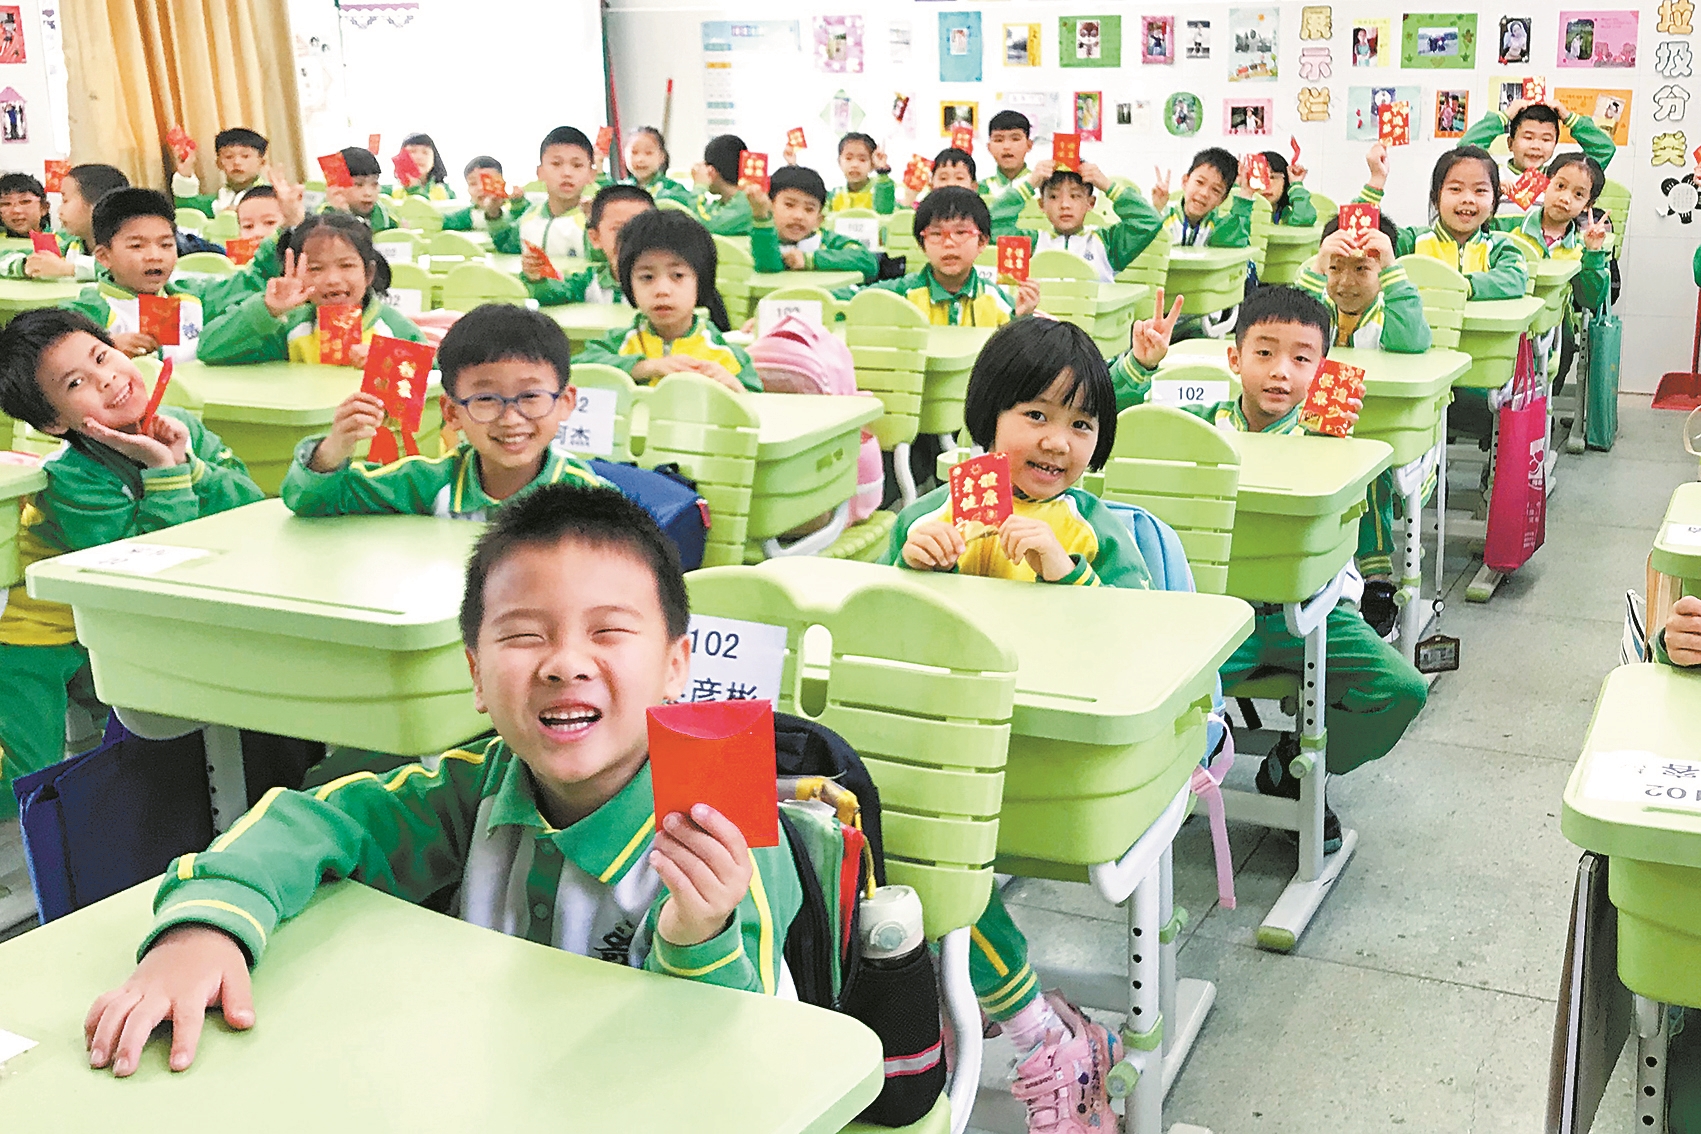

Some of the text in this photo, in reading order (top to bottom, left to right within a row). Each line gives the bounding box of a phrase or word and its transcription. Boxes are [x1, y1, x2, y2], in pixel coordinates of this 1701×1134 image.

[1297, 5, 1333, 122] 展示栏
[1178, 386, 1205, 401] 102
[690, 628, 740, 660] 102
[681, 677, 758, 702] 彦彬
